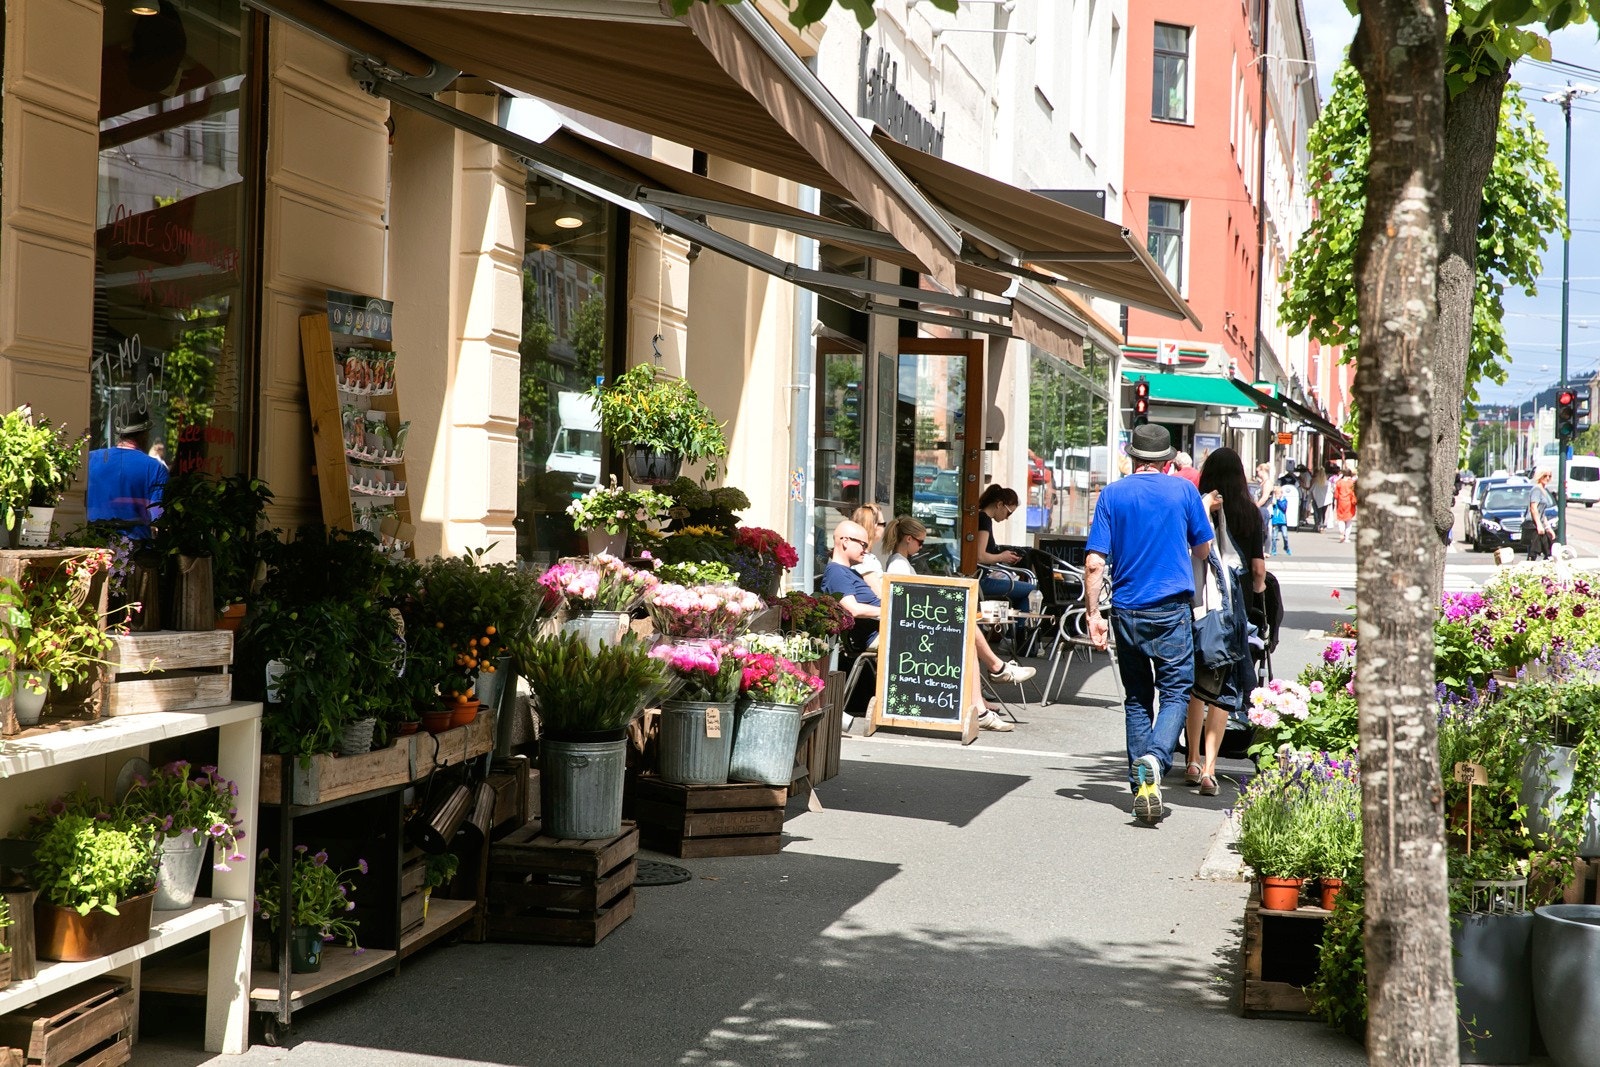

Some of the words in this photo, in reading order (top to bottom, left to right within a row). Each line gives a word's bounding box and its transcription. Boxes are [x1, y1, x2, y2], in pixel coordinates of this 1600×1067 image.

[111, 203, 157, 248] ALLE
[179, 413, 201, 443] Lee
[905, 593, 949, 624] Iste
[899, 619, 916, 629] Earl
[918, 634, 934, 653] &
[898, 651, 961, 680] Brioche
